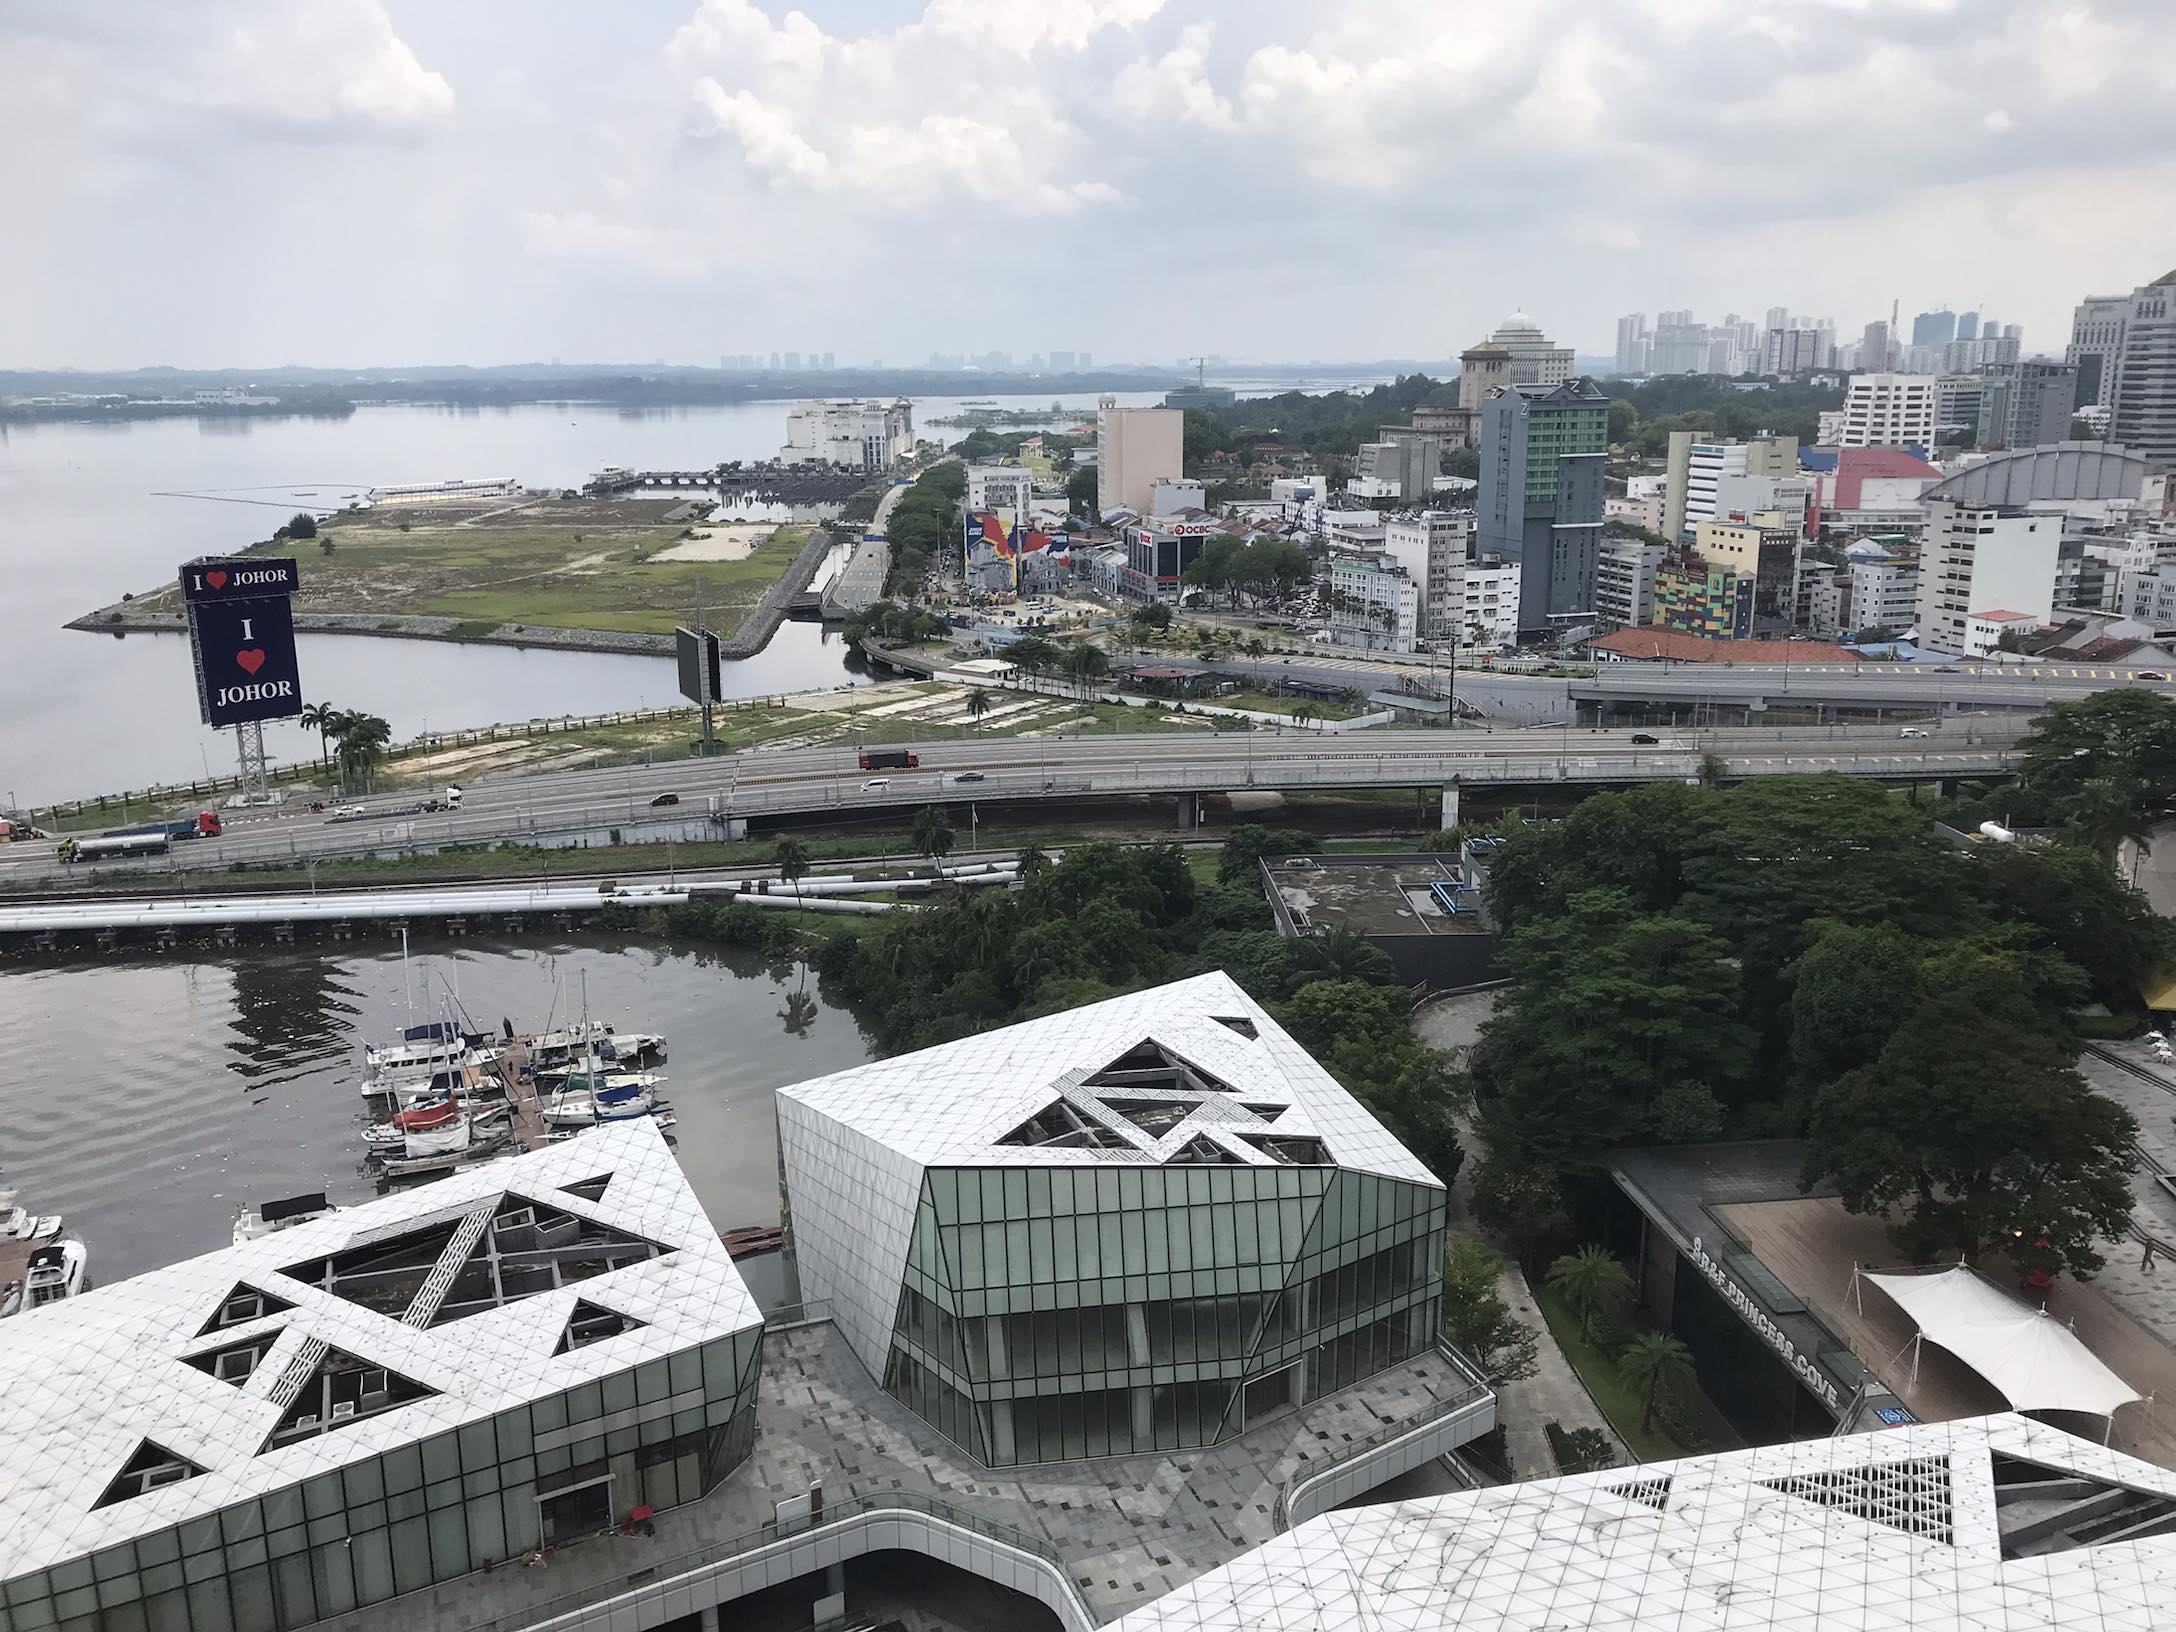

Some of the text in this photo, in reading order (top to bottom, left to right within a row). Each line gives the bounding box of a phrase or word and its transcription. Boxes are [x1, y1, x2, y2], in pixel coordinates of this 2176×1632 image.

[1520, 402, 1528, 416] Z
[1186, 525, 1210, 534] OCBC
[193, 569, 288, 591] I JOHOR
[241, 618, 254, 641] I
[217, 680, 293, 707] JOHOR
[1700, 1252, 1838, 1409] R&F PRINCESS COVE
